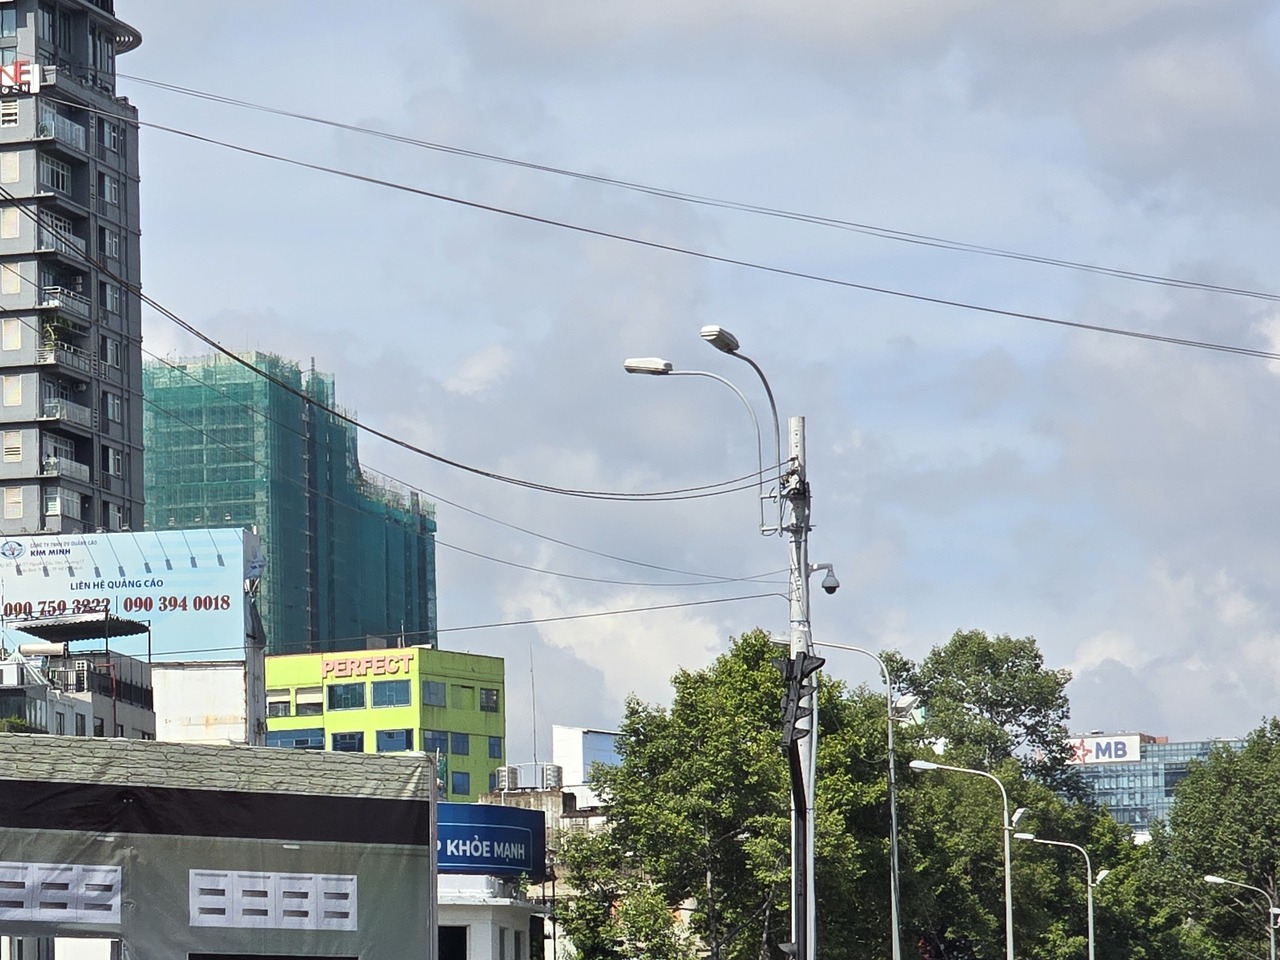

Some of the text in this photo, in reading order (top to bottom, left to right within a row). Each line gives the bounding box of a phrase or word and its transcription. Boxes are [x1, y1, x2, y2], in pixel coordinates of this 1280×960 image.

[30, 549, 46, 557] KIM
[48, 548, 71, 557] MINH
[70, 578, 164, 592] LIÊN HỆ QUẢNG CÁO
[4, 601, 33, 617] 090
[123, 594, 231, 613] 090 394 0018
[322, 653, 414, 679] PERFECT
[1095, 740, 1128, 760] MB
[446, 835, 491, 857] KHỎE
[493, 841, 525, 862] MẠNH
